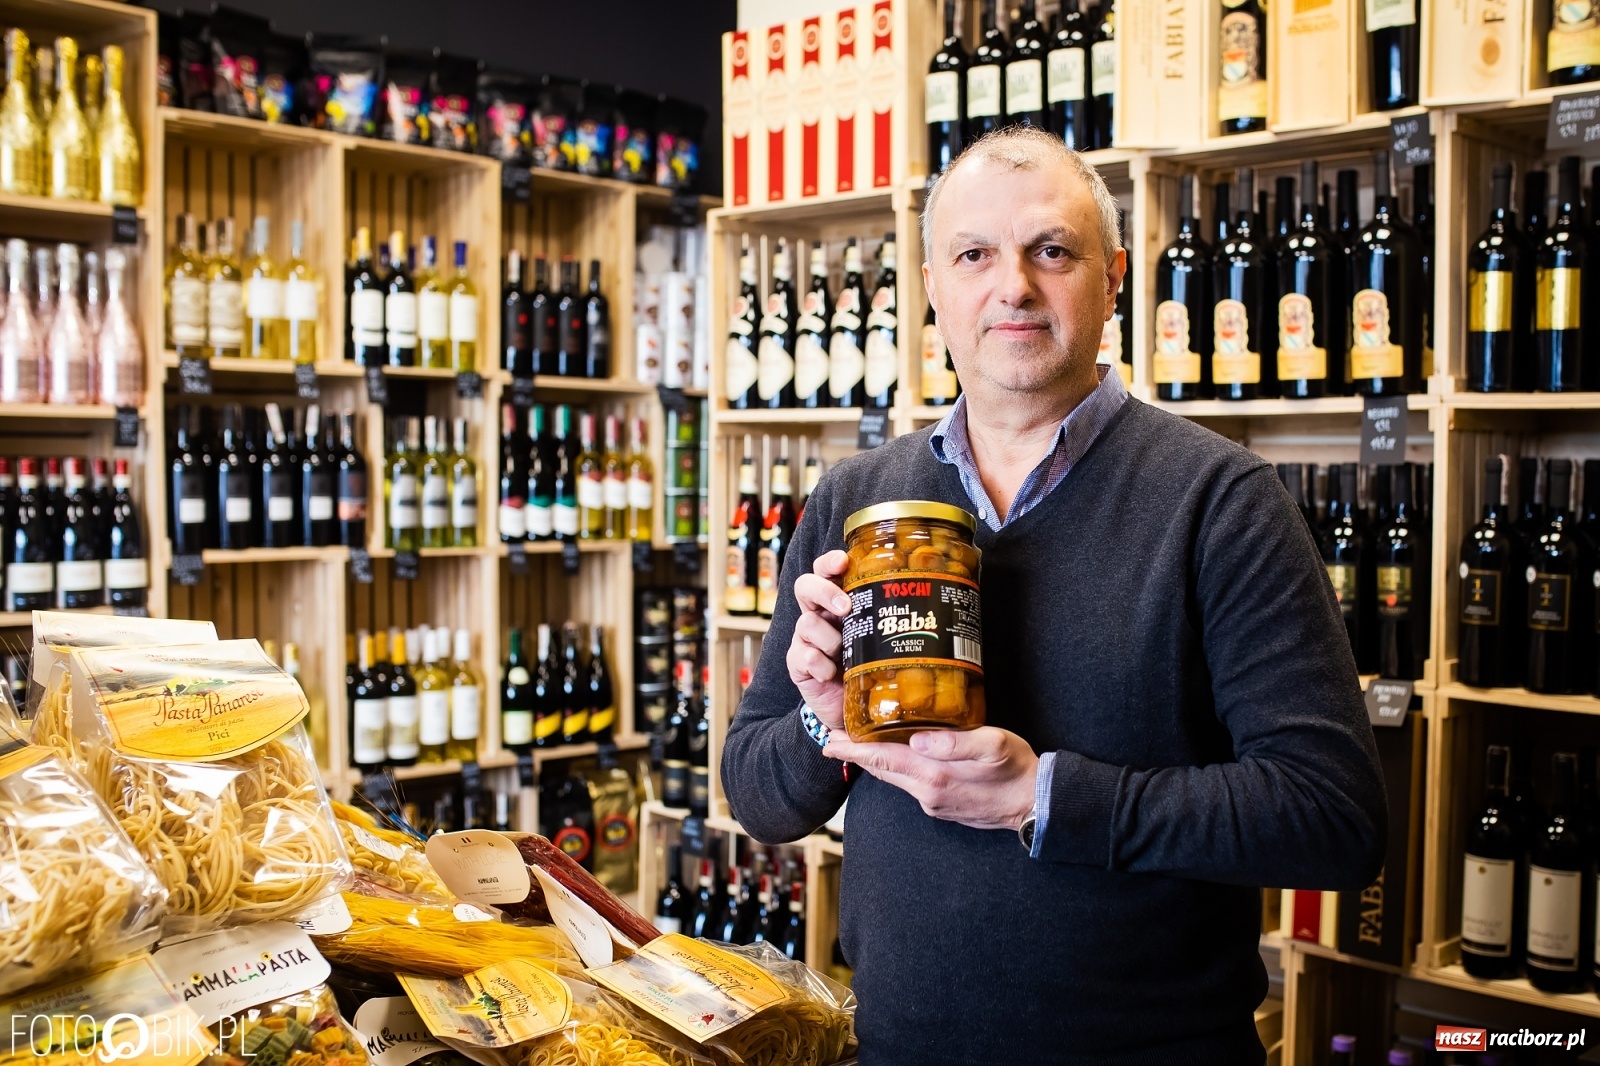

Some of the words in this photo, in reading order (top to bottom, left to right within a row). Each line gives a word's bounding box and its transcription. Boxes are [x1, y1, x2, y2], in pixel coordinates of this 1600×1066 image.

[882, 582, 931, 598] TOSCHI
[878, 604, 909, 617] Mini
[877, 610, 938, 636] Babà
[891, 639, 925, 647] CLASSICI
[153, 692, 201, 727] Pasta
[207, 729, 230, 742] Pici
